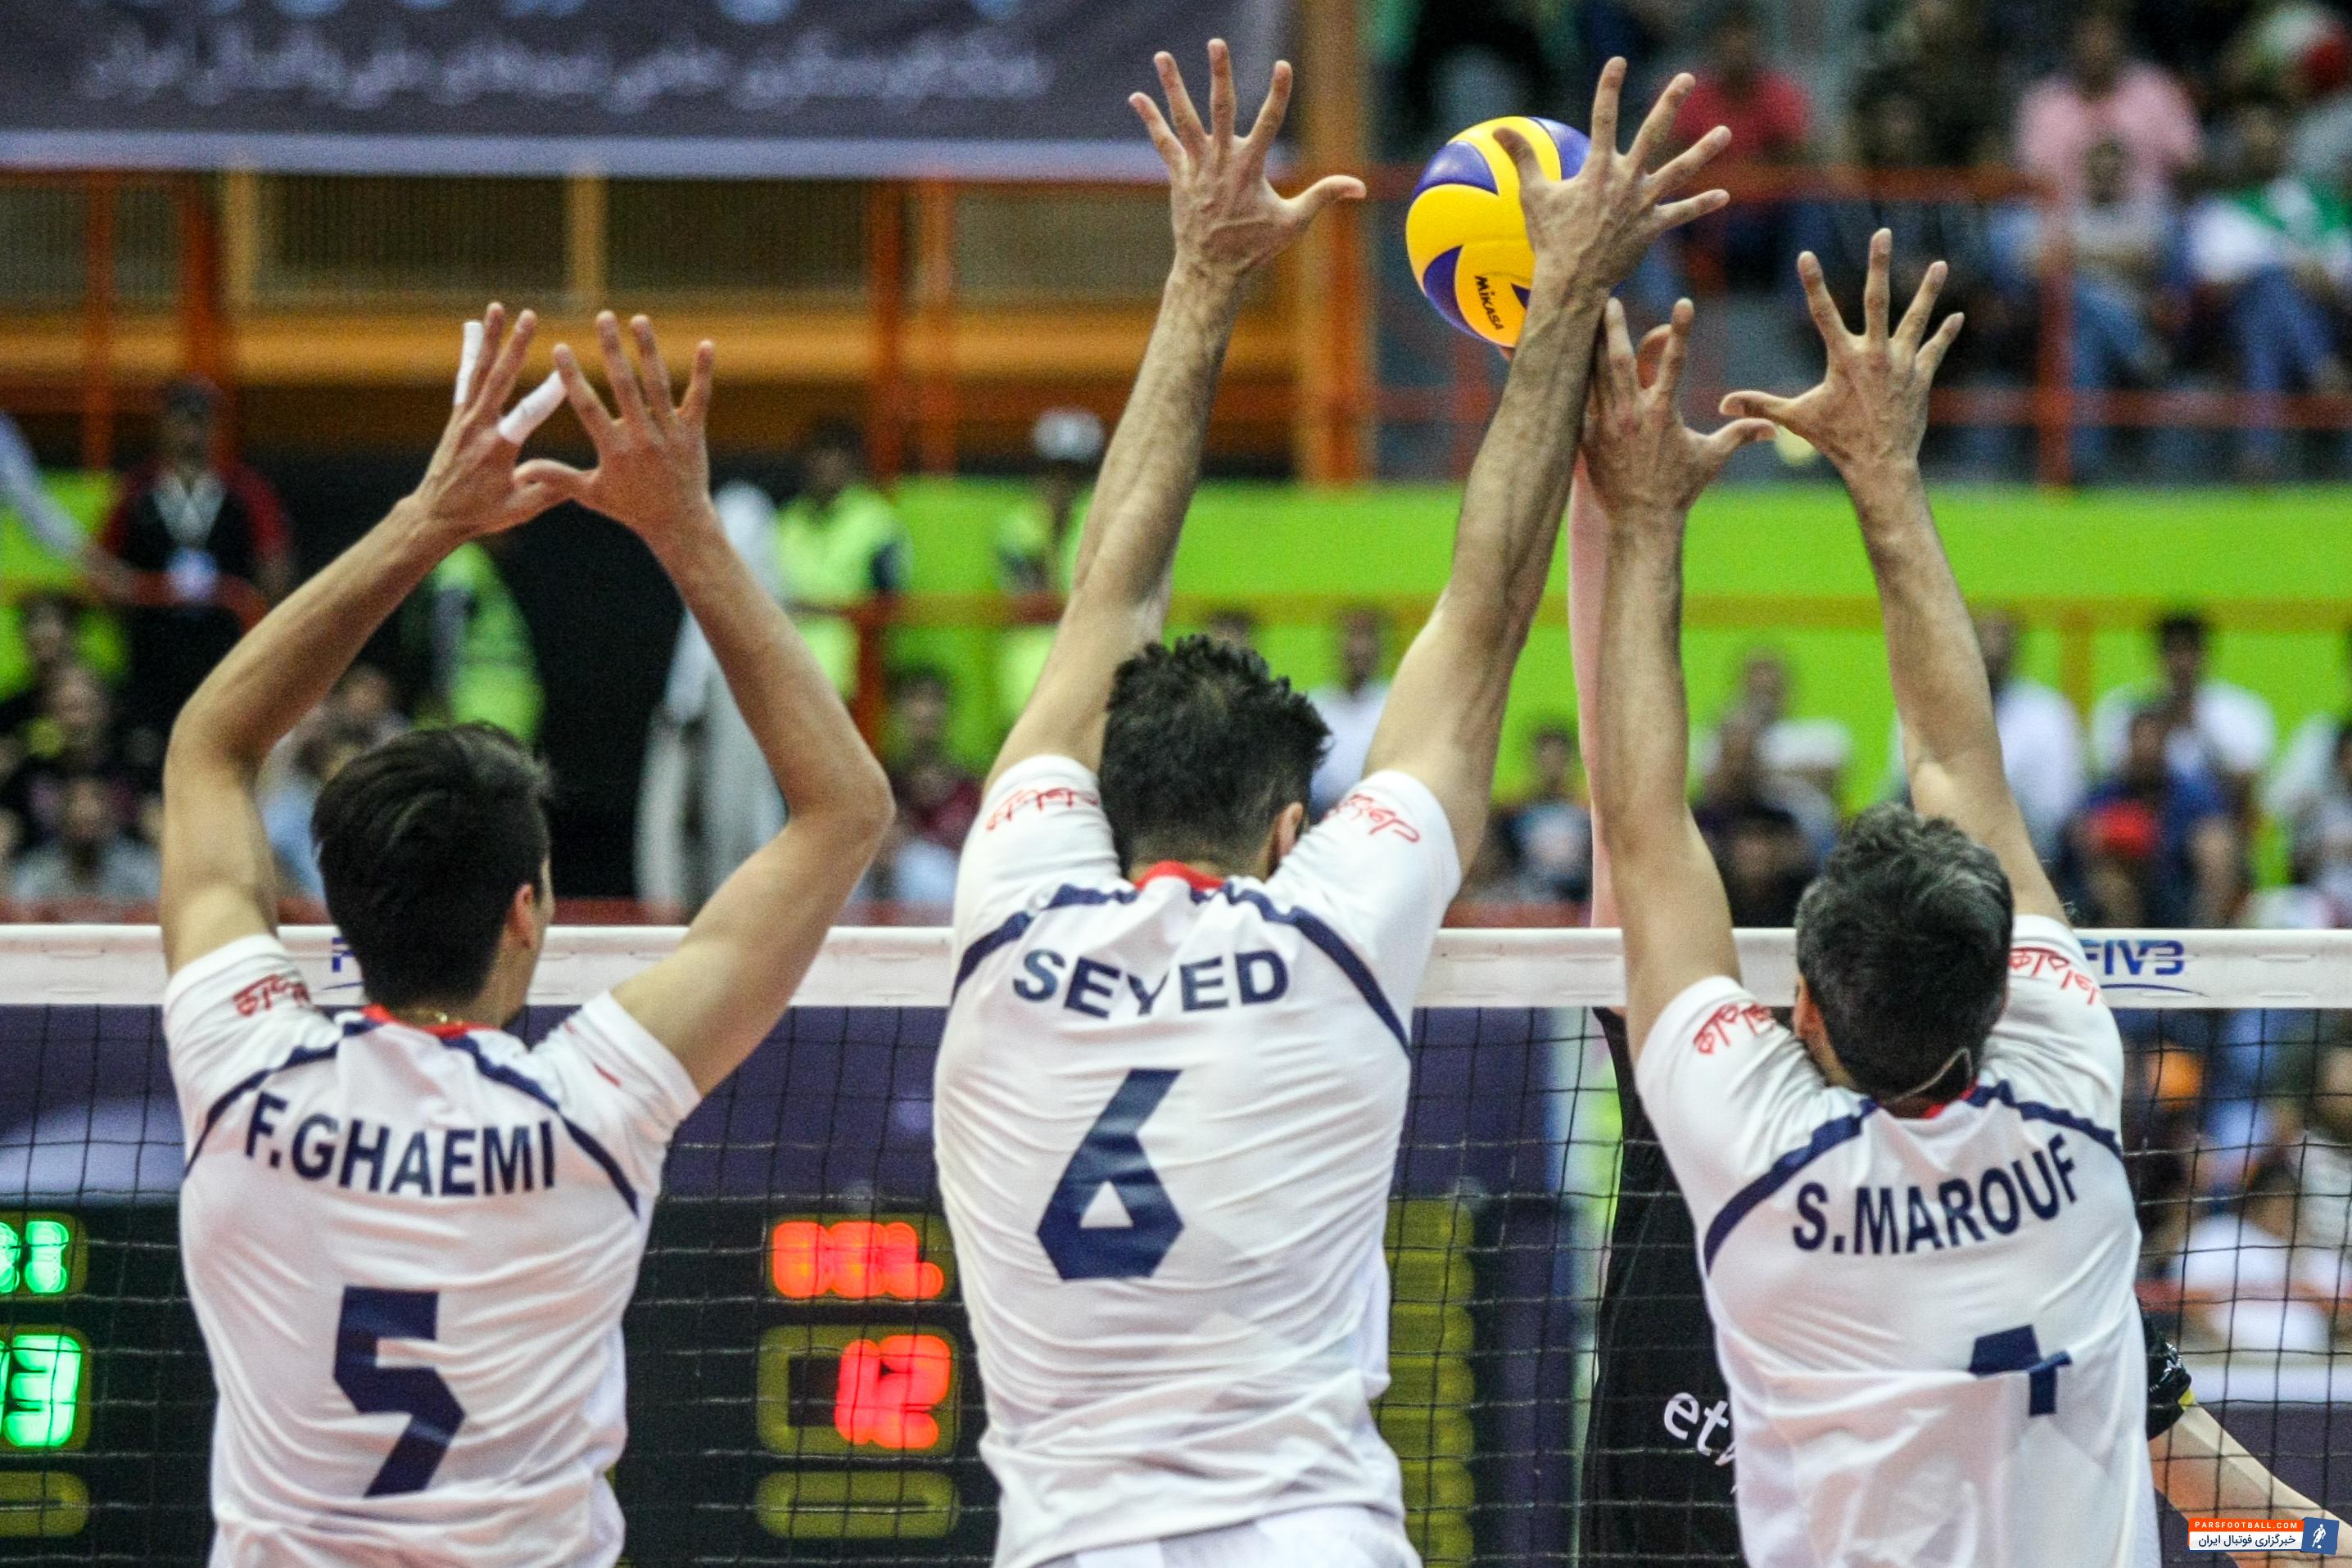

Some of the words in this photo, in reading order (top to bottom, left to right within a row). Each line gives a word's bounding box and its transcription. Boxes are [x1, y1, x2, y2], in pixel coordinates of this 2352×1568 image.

[1012, 948, 1290, 1019] SEYED
[245, 1091, 556, 1196] F.GHAEMI
[1037, 1069, 1185, 1281] 6
[1792, 1132, 2078, 1255] S.MAROUF
[333, 1286, 466, 1498] 5
[1664, 1392, 1735, 1466] et
